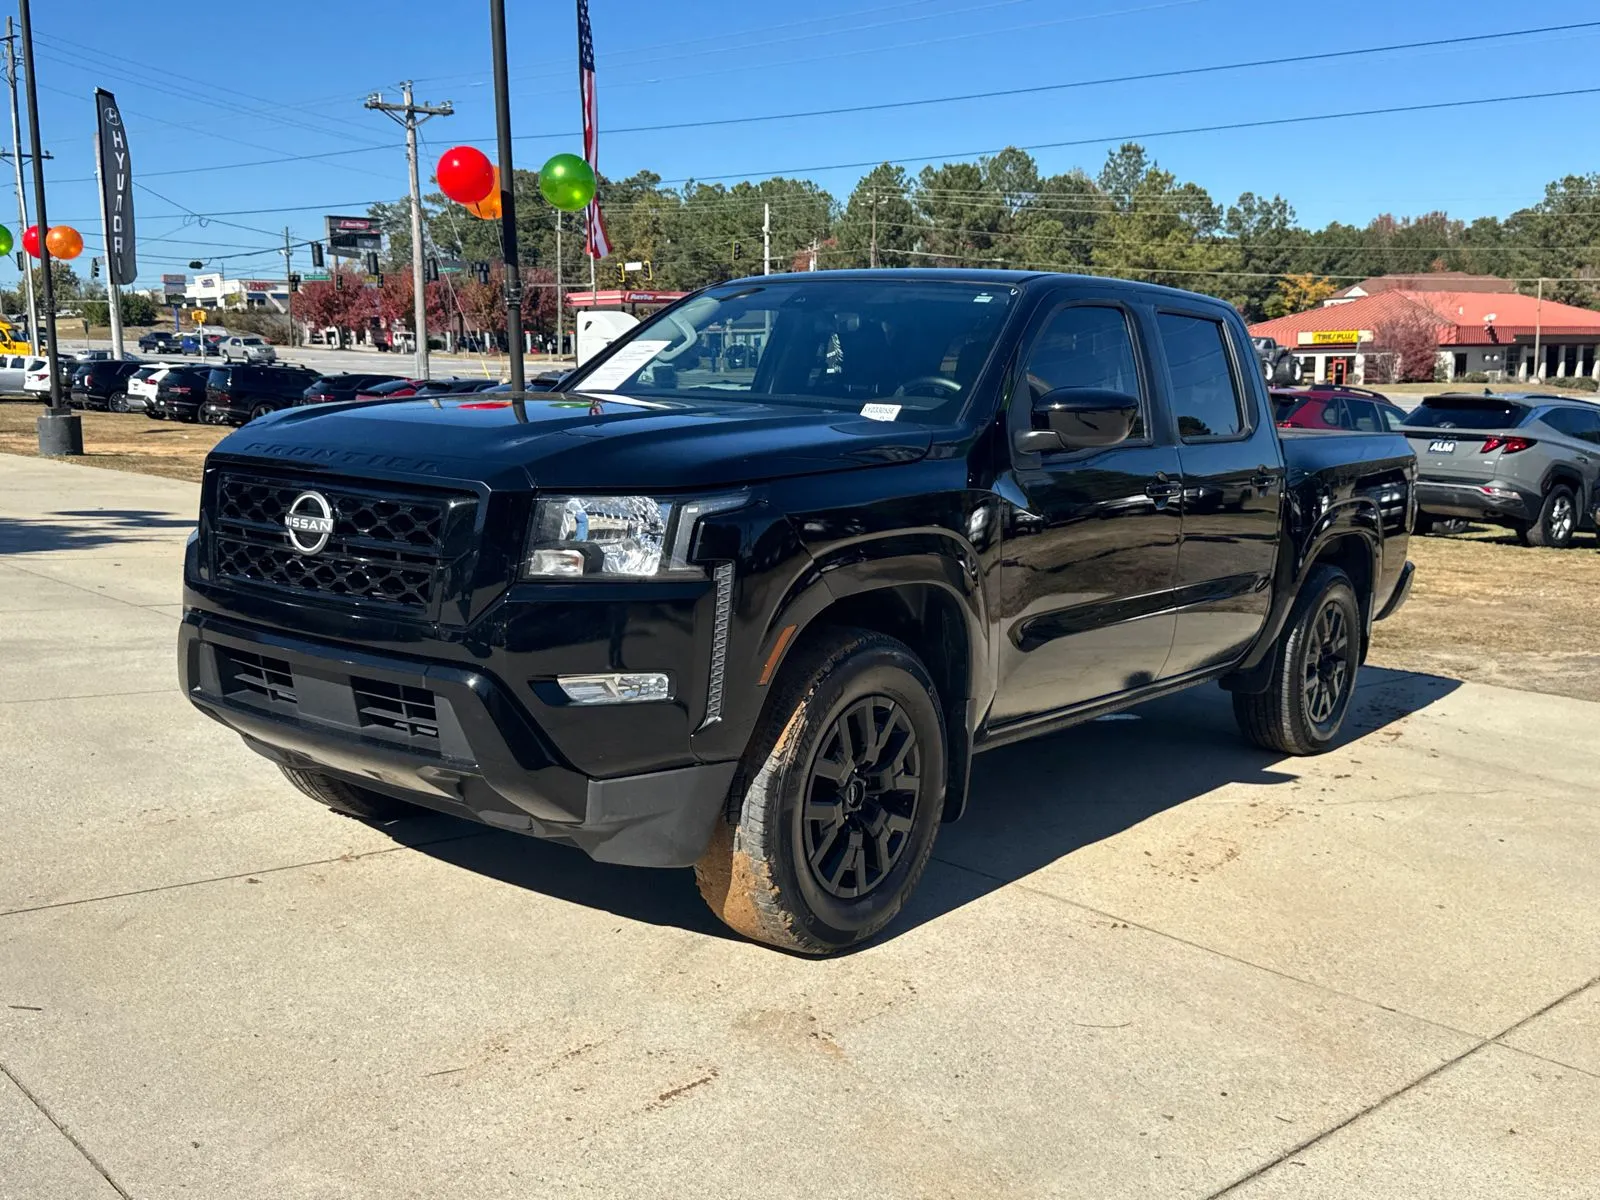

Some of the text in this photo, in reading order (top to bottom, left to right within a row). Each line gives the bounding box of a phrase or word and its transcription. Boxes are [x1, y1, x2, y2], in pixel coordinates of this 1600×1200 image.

[112, 130, 126, 274] HYUNDAI
[243, 442, 441, 473] FRONTIER
[1429, 441, 1455, 452] ALM
[284, 515, 333, 531] NISSAN
